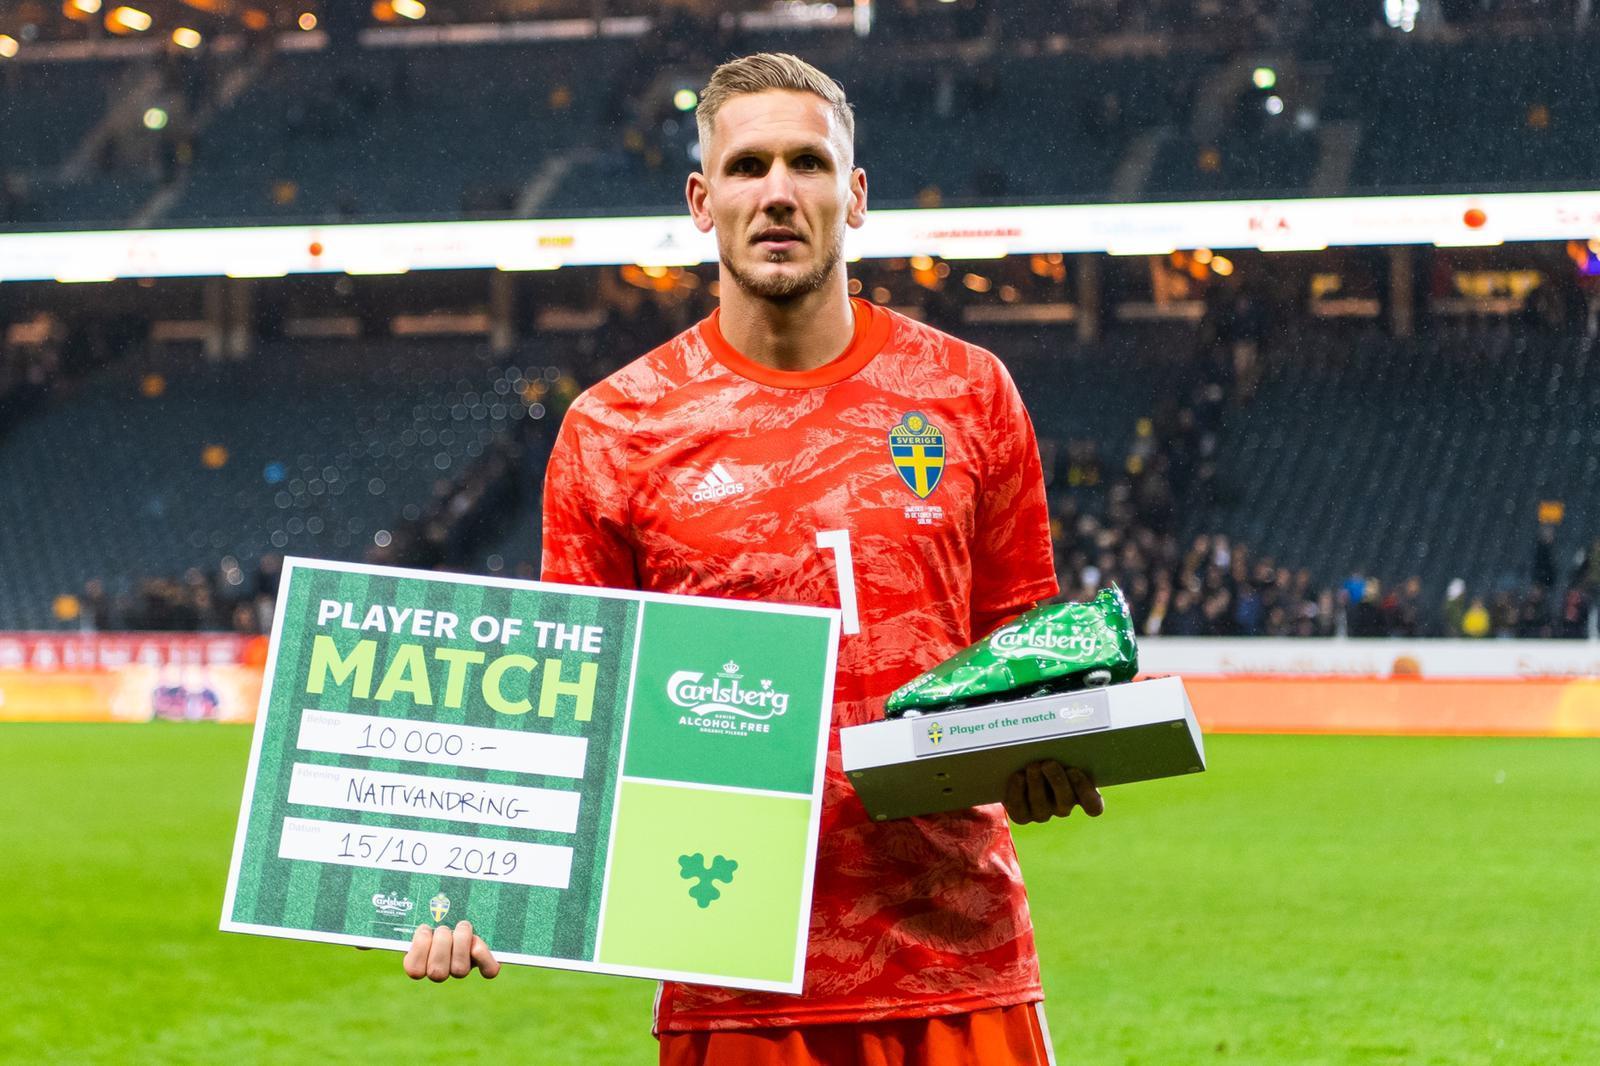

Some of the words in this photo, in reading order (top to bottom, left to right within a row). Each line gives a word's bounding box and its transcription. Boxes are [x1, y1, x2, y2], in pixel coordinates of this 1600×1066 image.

[692, 482, 744, 502] adidas
[816, 529, 860, 635] 1
[317, 599, 459, 639] PLAYER
[470, 615, 523, 645] OF
[533, 620, 604, 653] THE
[990, 625, 1097, 657] Carlsberg
[306, 634, 599, 722] MATCH
[667, 670, 790, 716] Carlsberg
[306, 714, 342, 726] Belopp
[679, 716, 737, 730] ALCOHOL
[740, 721, 771, 733] FREE
[949, 723, 985, 736] Player
[988, 719, 1000, 730] of
[1002, 717, 1019, 728] the
[1021, 711, 1057, 724] match
[287, 822, 321, 834] Datum
[338, 832, 428, 867] 15/10
[444, 847, 518, 876] 2019
